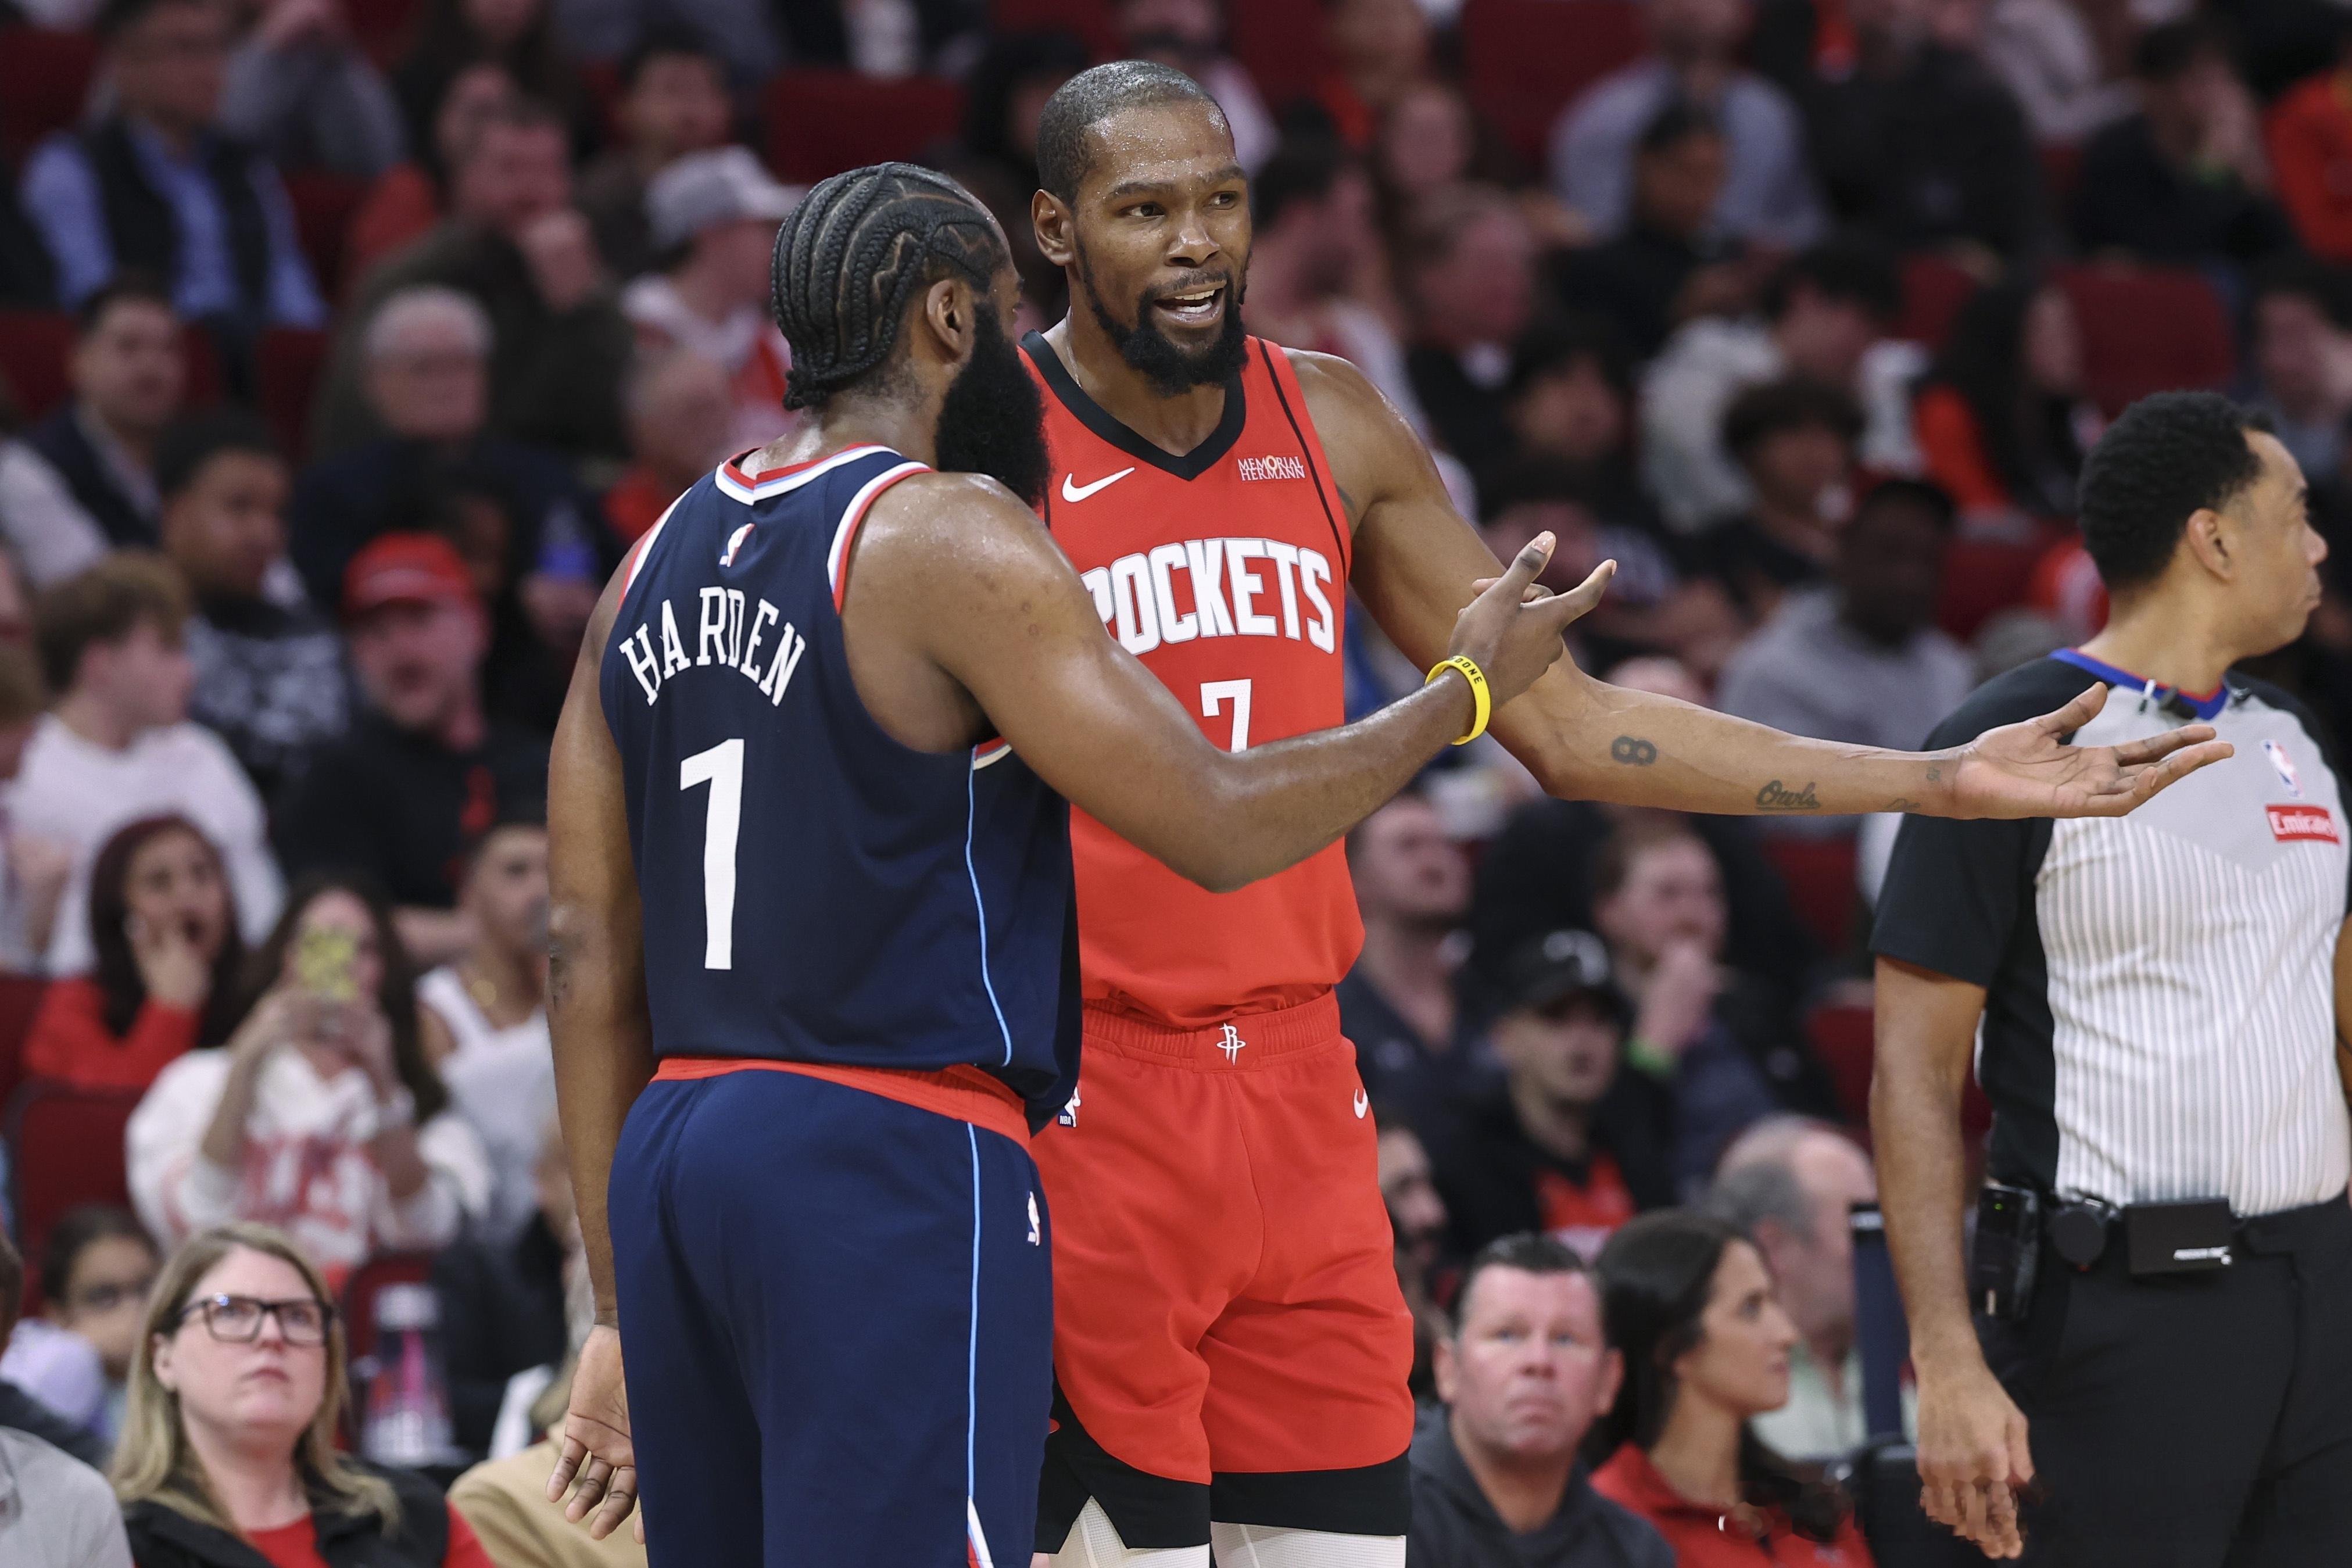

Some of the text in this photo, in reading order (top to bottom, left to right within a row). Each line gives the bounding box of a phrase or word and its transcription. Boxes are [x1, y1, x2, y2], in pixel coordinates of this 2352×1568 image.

[1238, 455, 1304, 470] MEMORIAL
[1240, 466, 1305, 481] HERMANN
[619, 586, 806, 707] HARDEN
[1200, 678, 1252, 754] 7
[1756, 780, 1821, 811] Owls
[681, 739, 744, 970] 1
[1059, 1115, 1072, 1125] NBA
